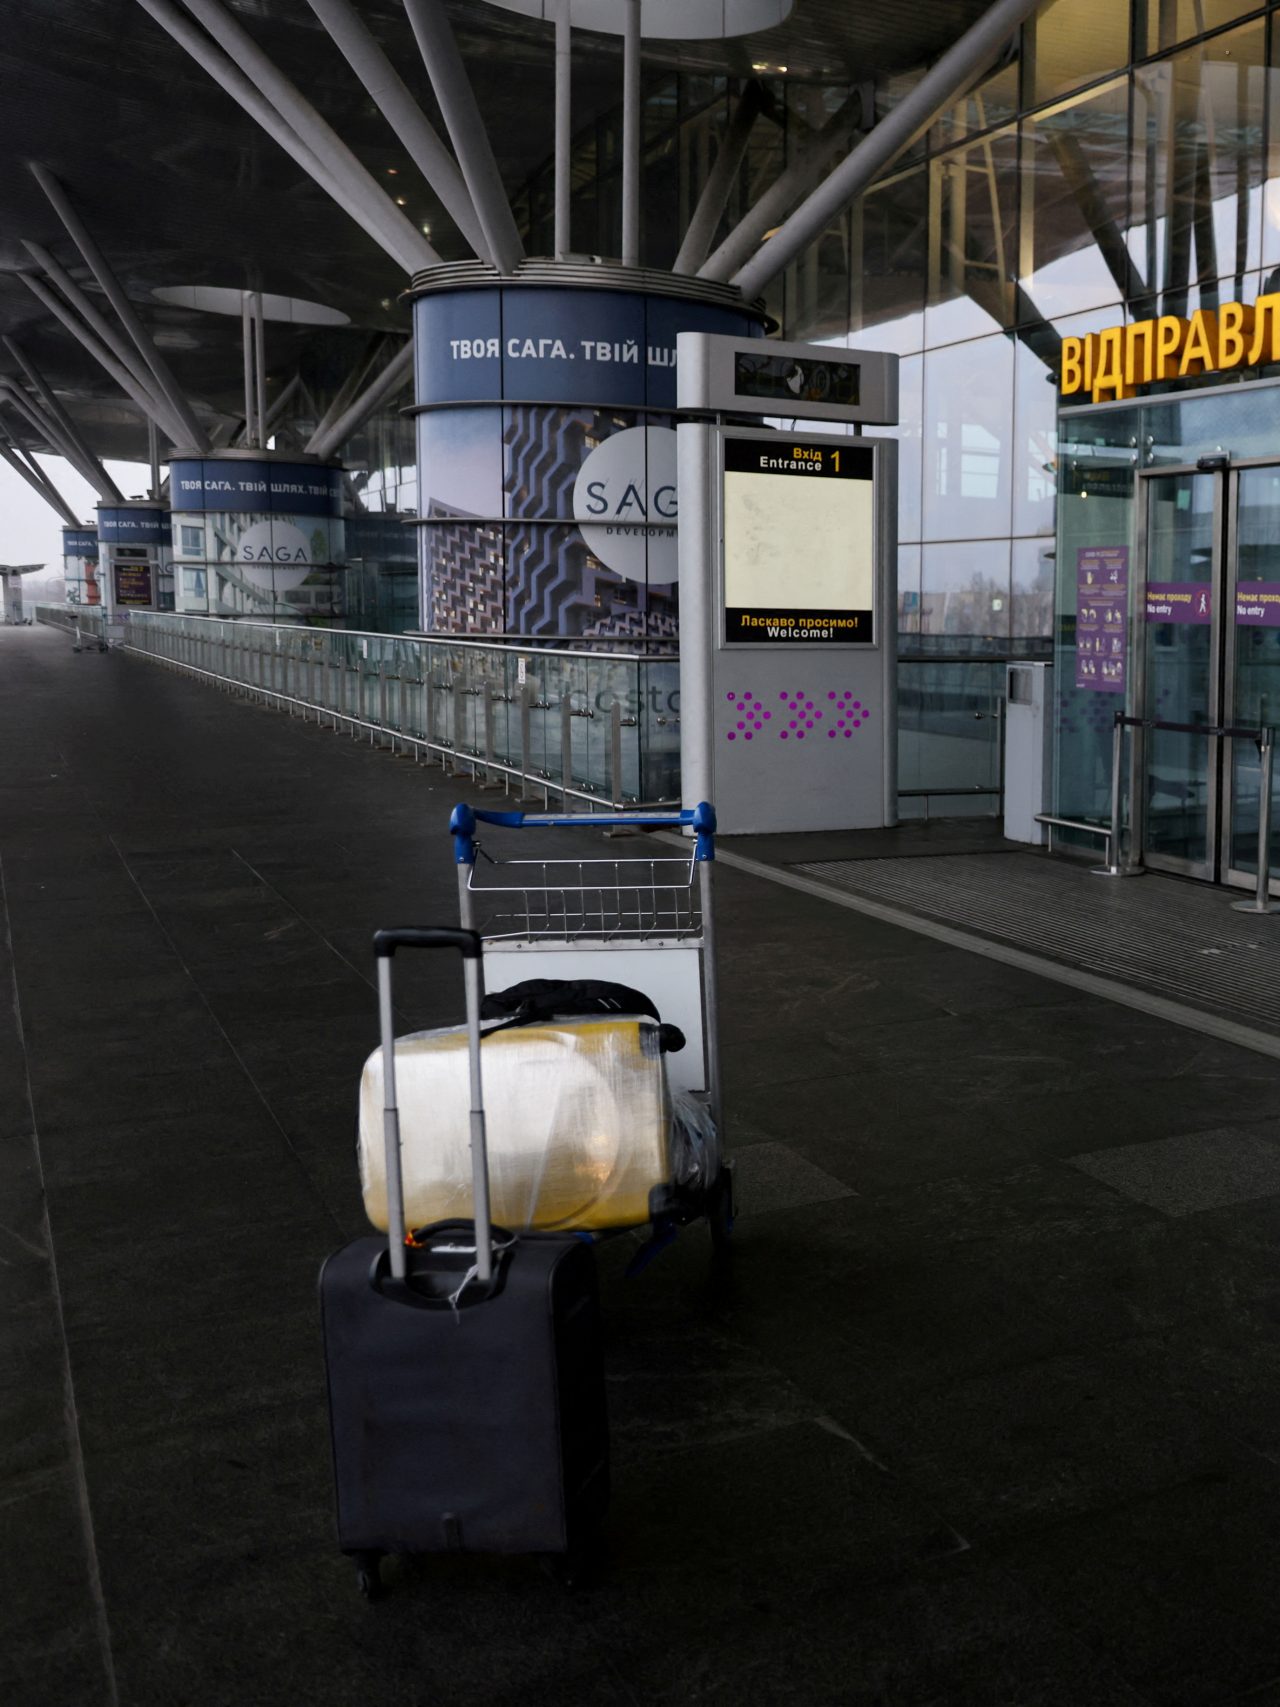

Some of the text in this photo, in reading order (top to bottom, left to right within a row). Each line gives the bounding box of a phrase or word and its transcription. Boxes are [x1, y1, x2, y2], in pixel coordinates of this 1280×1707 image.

[450, 338, 500, 360] ТВОЯ
[507, 338, 575, 360] САГА.
[581, 339, 638, 364] ТВІЙ
[759, 456, 822, 471] Entrance
[793, 447, 840, 472] Вхід 1
[180, 480, 201, 490] ТВОЯ
[204, 480, 235, 491] САГА.
[238, 481, 267, 492] ТВІЙ
[271, 482, 307, 494] ШЛЯХ.
[606, 527, 679, 537] DEVELOPM
[243, 545, 308, 562] SAGA
[1156, 605, 1172, 616] entry
[1237, 605, 1265, 618] No entry
[741, 615, 859, 629] Ласкаво просимо!
[767, 626, 834, 638] Welcome!
